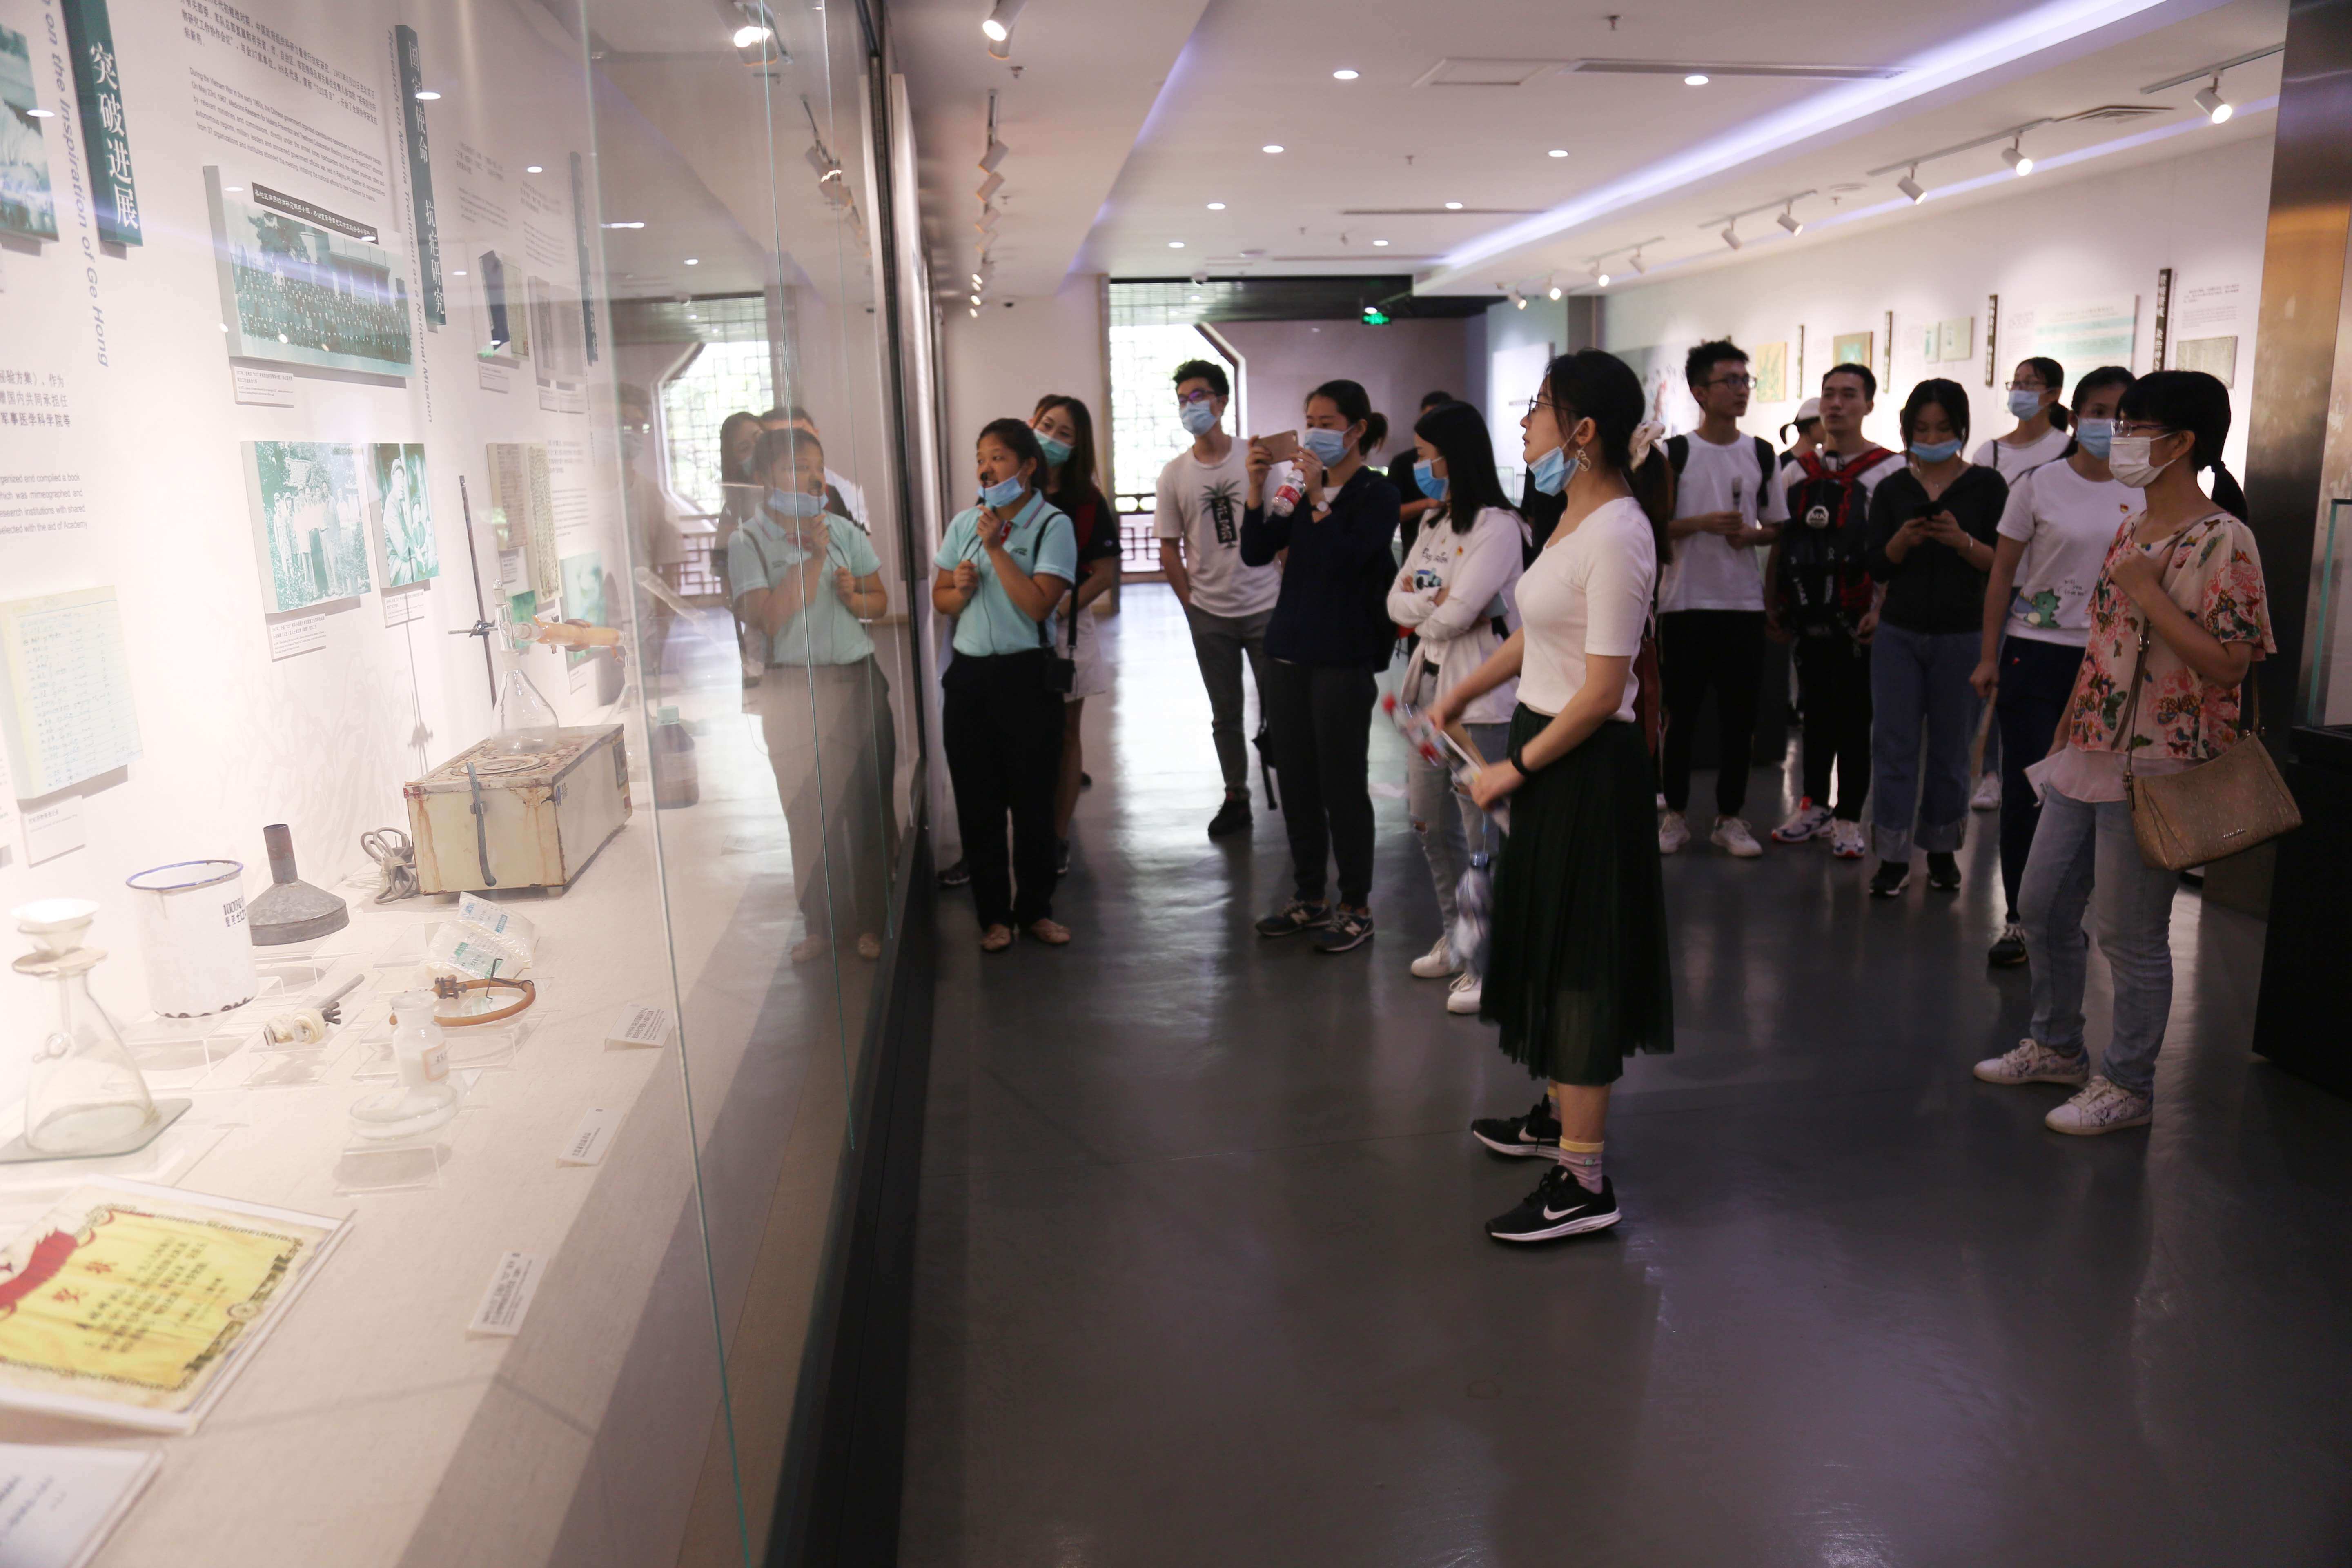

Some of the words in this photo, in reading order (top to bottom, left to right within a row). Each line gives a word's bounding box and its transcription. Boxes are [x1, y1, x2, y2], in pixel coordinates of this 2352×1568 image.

[45, 13, 58, 45] on
[52, 53, 65, 92] the
[388, 29, 399, 102] Research
[90, 42, 139, 229] 突破进展
[396, 107, 401, 126] on
[60, 98, 87, 228] Inspiration
[398, 131, 408, 184] Malaria
[82, 236, 95, 263] of
[405, 191, 416, 265] Treatment
[87, 267, 98, 298] Ge
[425, 199, 445, 314] 抗疟研究
[92, 305, 109, 368] Hong
[416, 303, 427, 363] National
[423, 367, 433, 423] Mission
[68, 473, 80, 481] book
